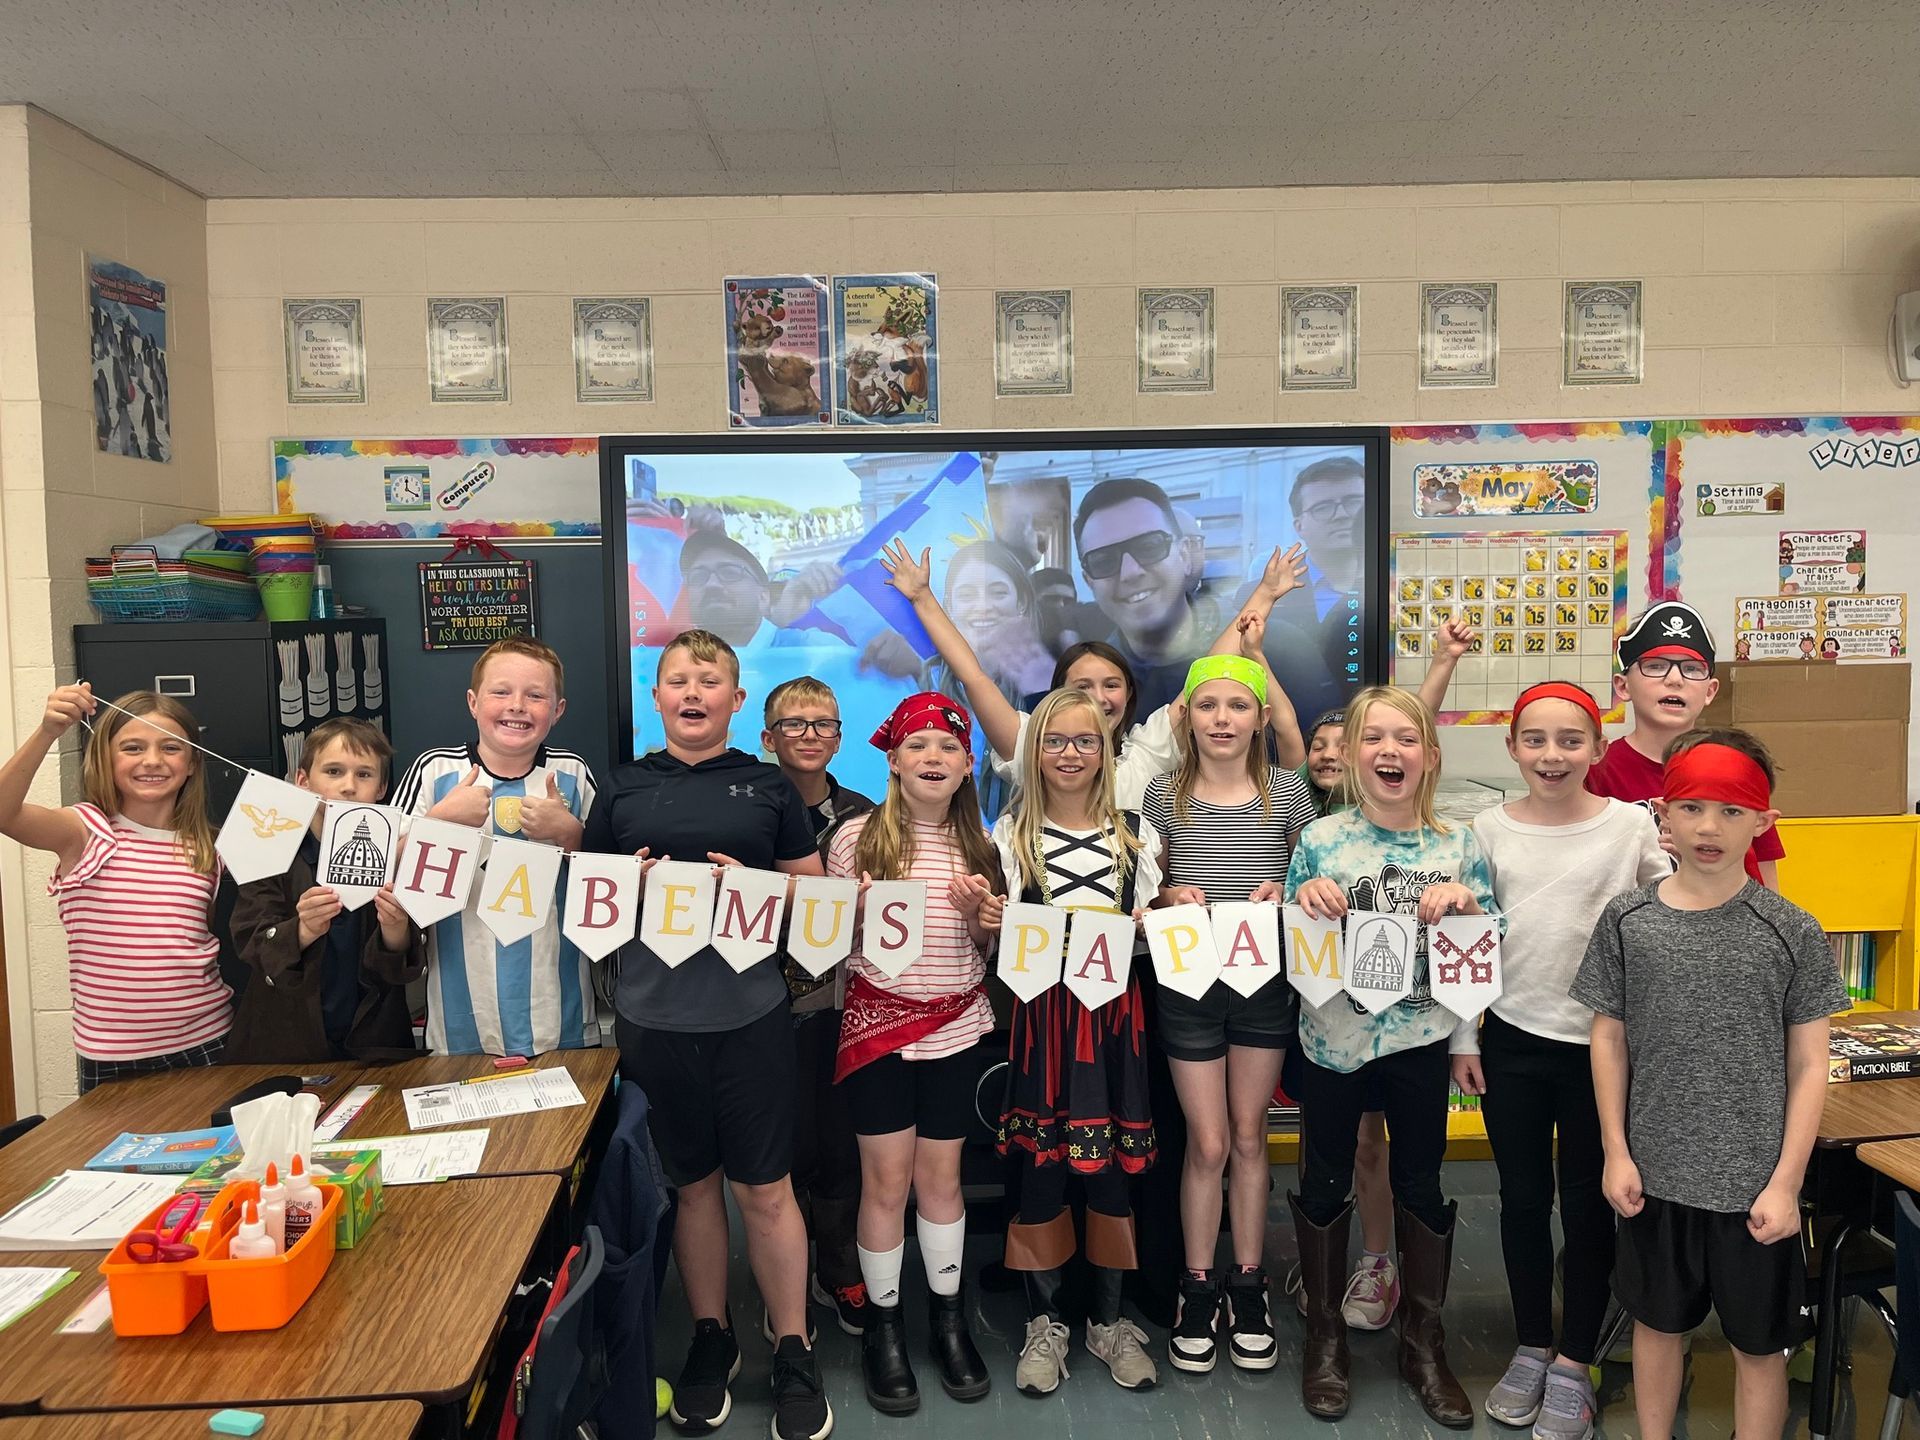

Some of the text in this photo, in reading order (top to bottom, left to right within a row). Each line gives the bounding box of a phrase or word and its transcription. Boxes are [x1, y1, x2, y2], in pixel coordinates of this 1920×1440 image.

[443, 469, 489, 504] Computer
[1481, 478, 1533, 502] May
[1793, 535, 1852, 543] Characters
[1569, 556, 1577, 568] 2
[1599, 556, 1607, 568] 3
[428, 570, 436, 579] IN
[438, 570, 457, 579] THIS
[459, 568, 504, 578] CLASSROOM
[429, 579, 527, 592] HELP OTHERS LEARN
[1444, 586, 1451, 597] 5
[1475, 585, 1482, 597] 6
[1507, 585, 1515, 597] 7
[1537, 584, 1544, 596] 8
[1568, 583, 1576, 595] 9
[1594, 583, 1608, 595] 10
[430, 605, 528, 616] WORK TOGETHER
[1746, 600, 1811, 609] Antagonist
[451, 616, 507, 627] TRY OUR BEST
[1409, 613, 1419, 626] 11
[1469, 612, 1480, 624] 13
[1500, 612, 1513, 624] 14
[1531, 611, 1544, 624] 15
[1562, 611, 1575, 622] 16
[1594, 610, 1608, 622] 17
[439, 628, 458, 641] ASK
[1743, 632, 1811, 640] Protagonist
[1406, 640, 1419, 652] 18
[1499, 639, 1511, 651] 21
[1528, 639, 1544, 651] 22
[1559, 638, 1575, 650] 23
[1406, 871, 1451, 885] No One
[1857, 1062, 1889, 1074] ACTION
[1891, 1061, 1910, 1072] BIBLE
